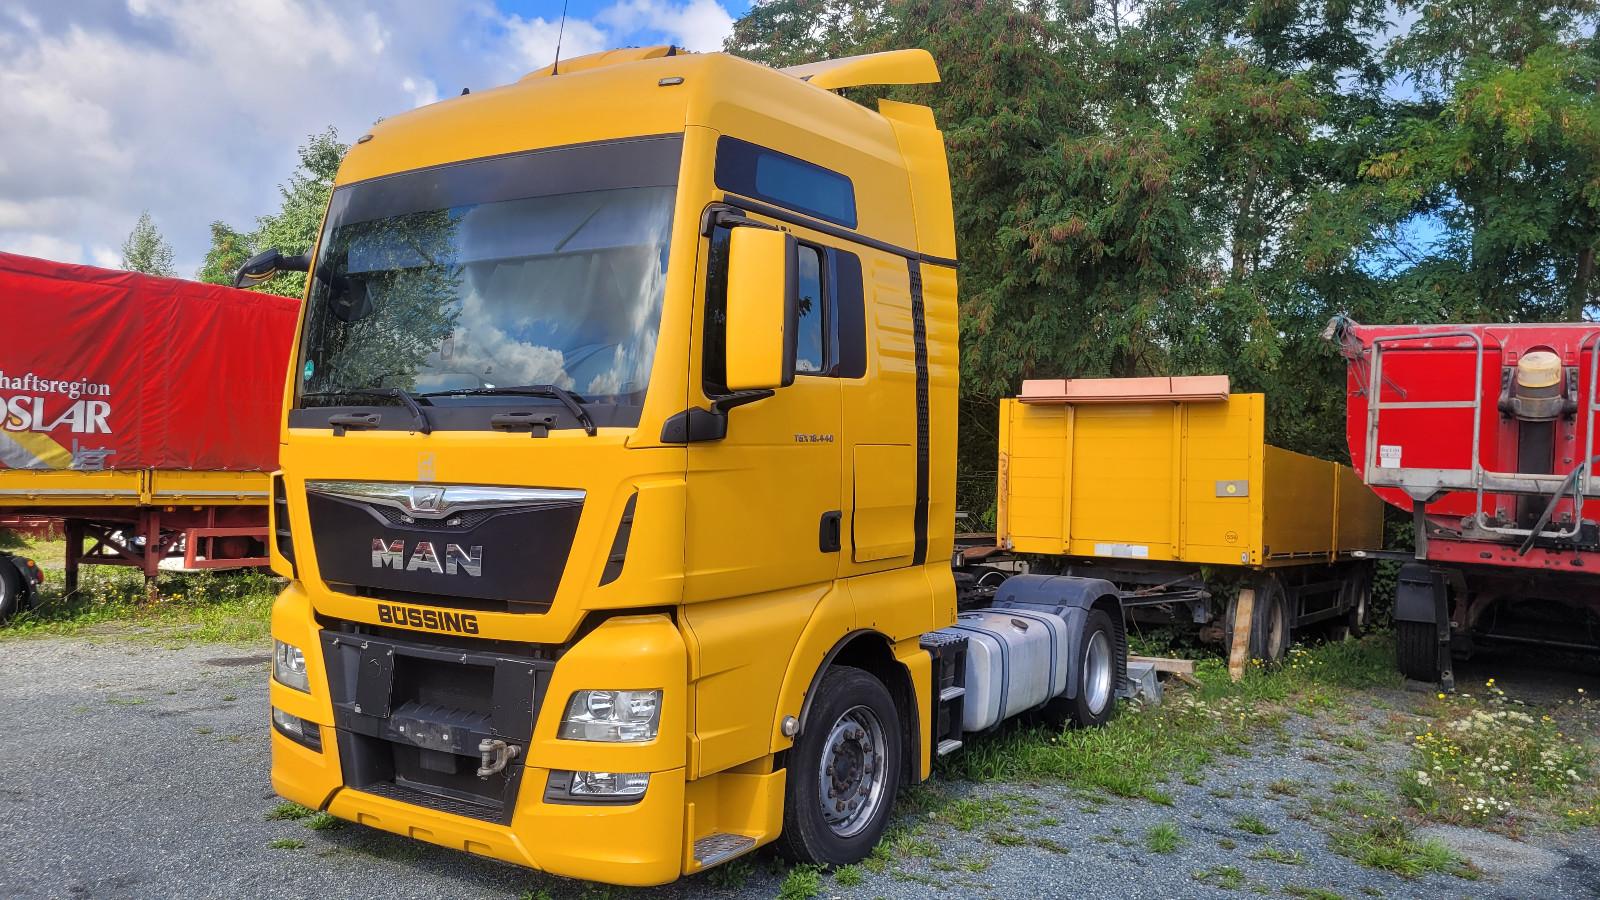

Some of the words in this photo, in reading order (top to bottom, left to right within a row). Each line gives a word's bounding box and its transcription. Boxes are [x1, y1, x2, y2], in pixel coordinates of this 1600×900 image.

[0, 395, 113, 434] SLAR
[371, 538, 483, 577] MAN
[377, 603, 479, 635] BÜSSING
